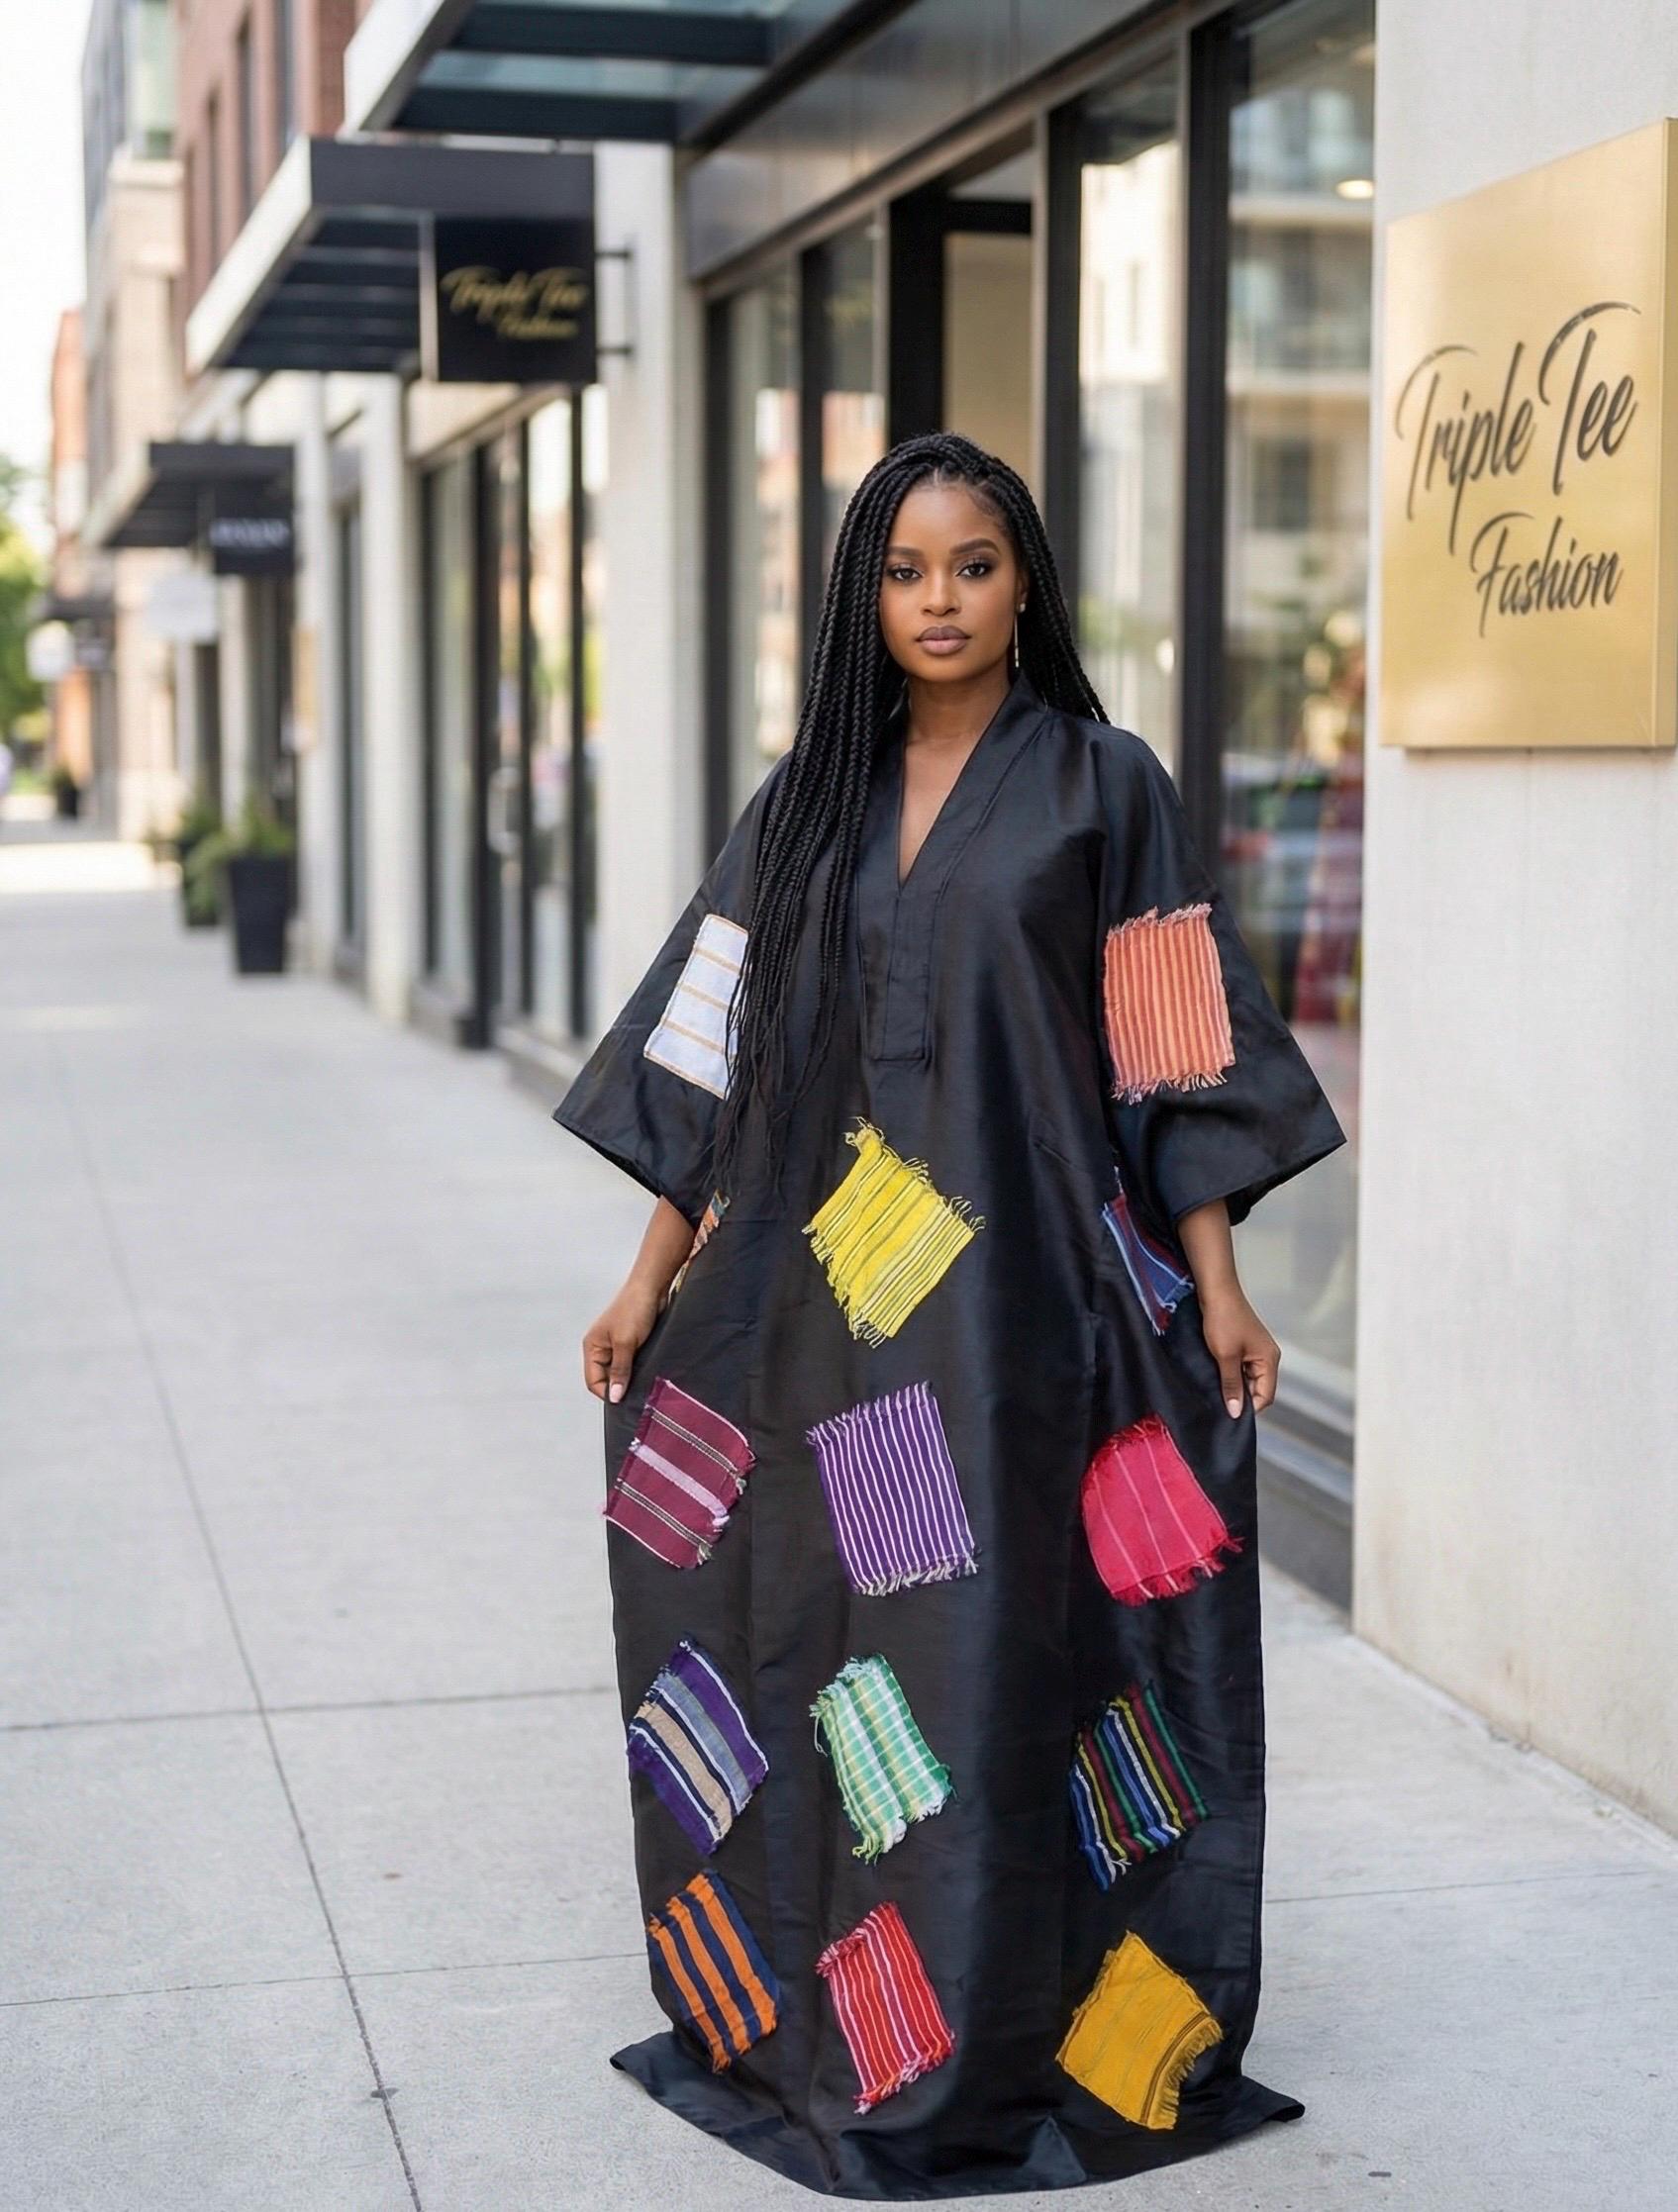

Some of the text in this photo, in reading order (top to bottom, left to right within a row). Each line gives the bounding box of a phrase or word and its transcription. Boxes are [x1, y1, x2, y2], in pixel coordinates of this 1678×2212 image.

[1395, 301, 1641, 556] Triple Tee
[1469, 512, 1624, 638] Fashion
